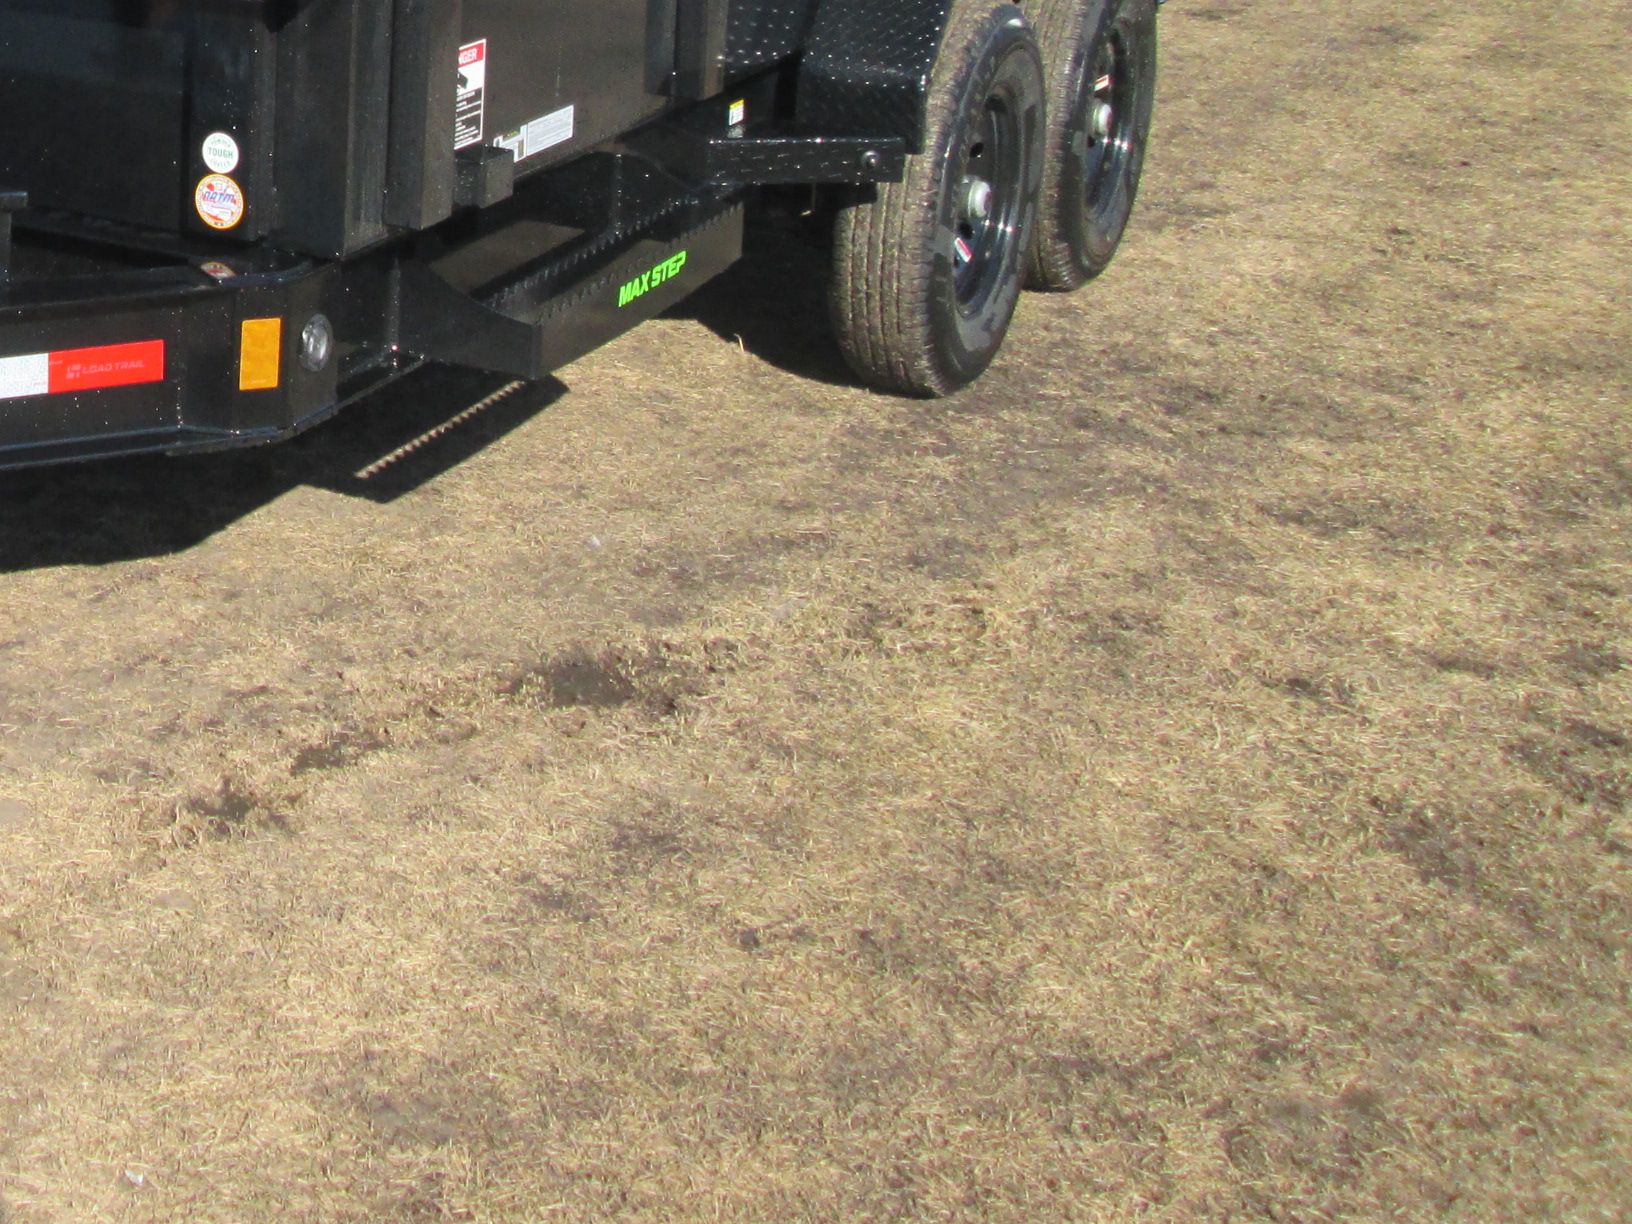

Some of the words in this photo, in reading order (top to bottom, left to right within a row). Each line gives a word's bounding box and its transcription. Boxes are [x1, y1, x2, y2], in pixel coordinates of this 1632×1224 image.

[207, 146, 234, 160] TOUGH
[618, 270, 651, 308] MAX
[651, 250, 687, 288] STEP
[81, 362, 112, 374] LOAD
[112, 359, 146, 371] TRAIL
